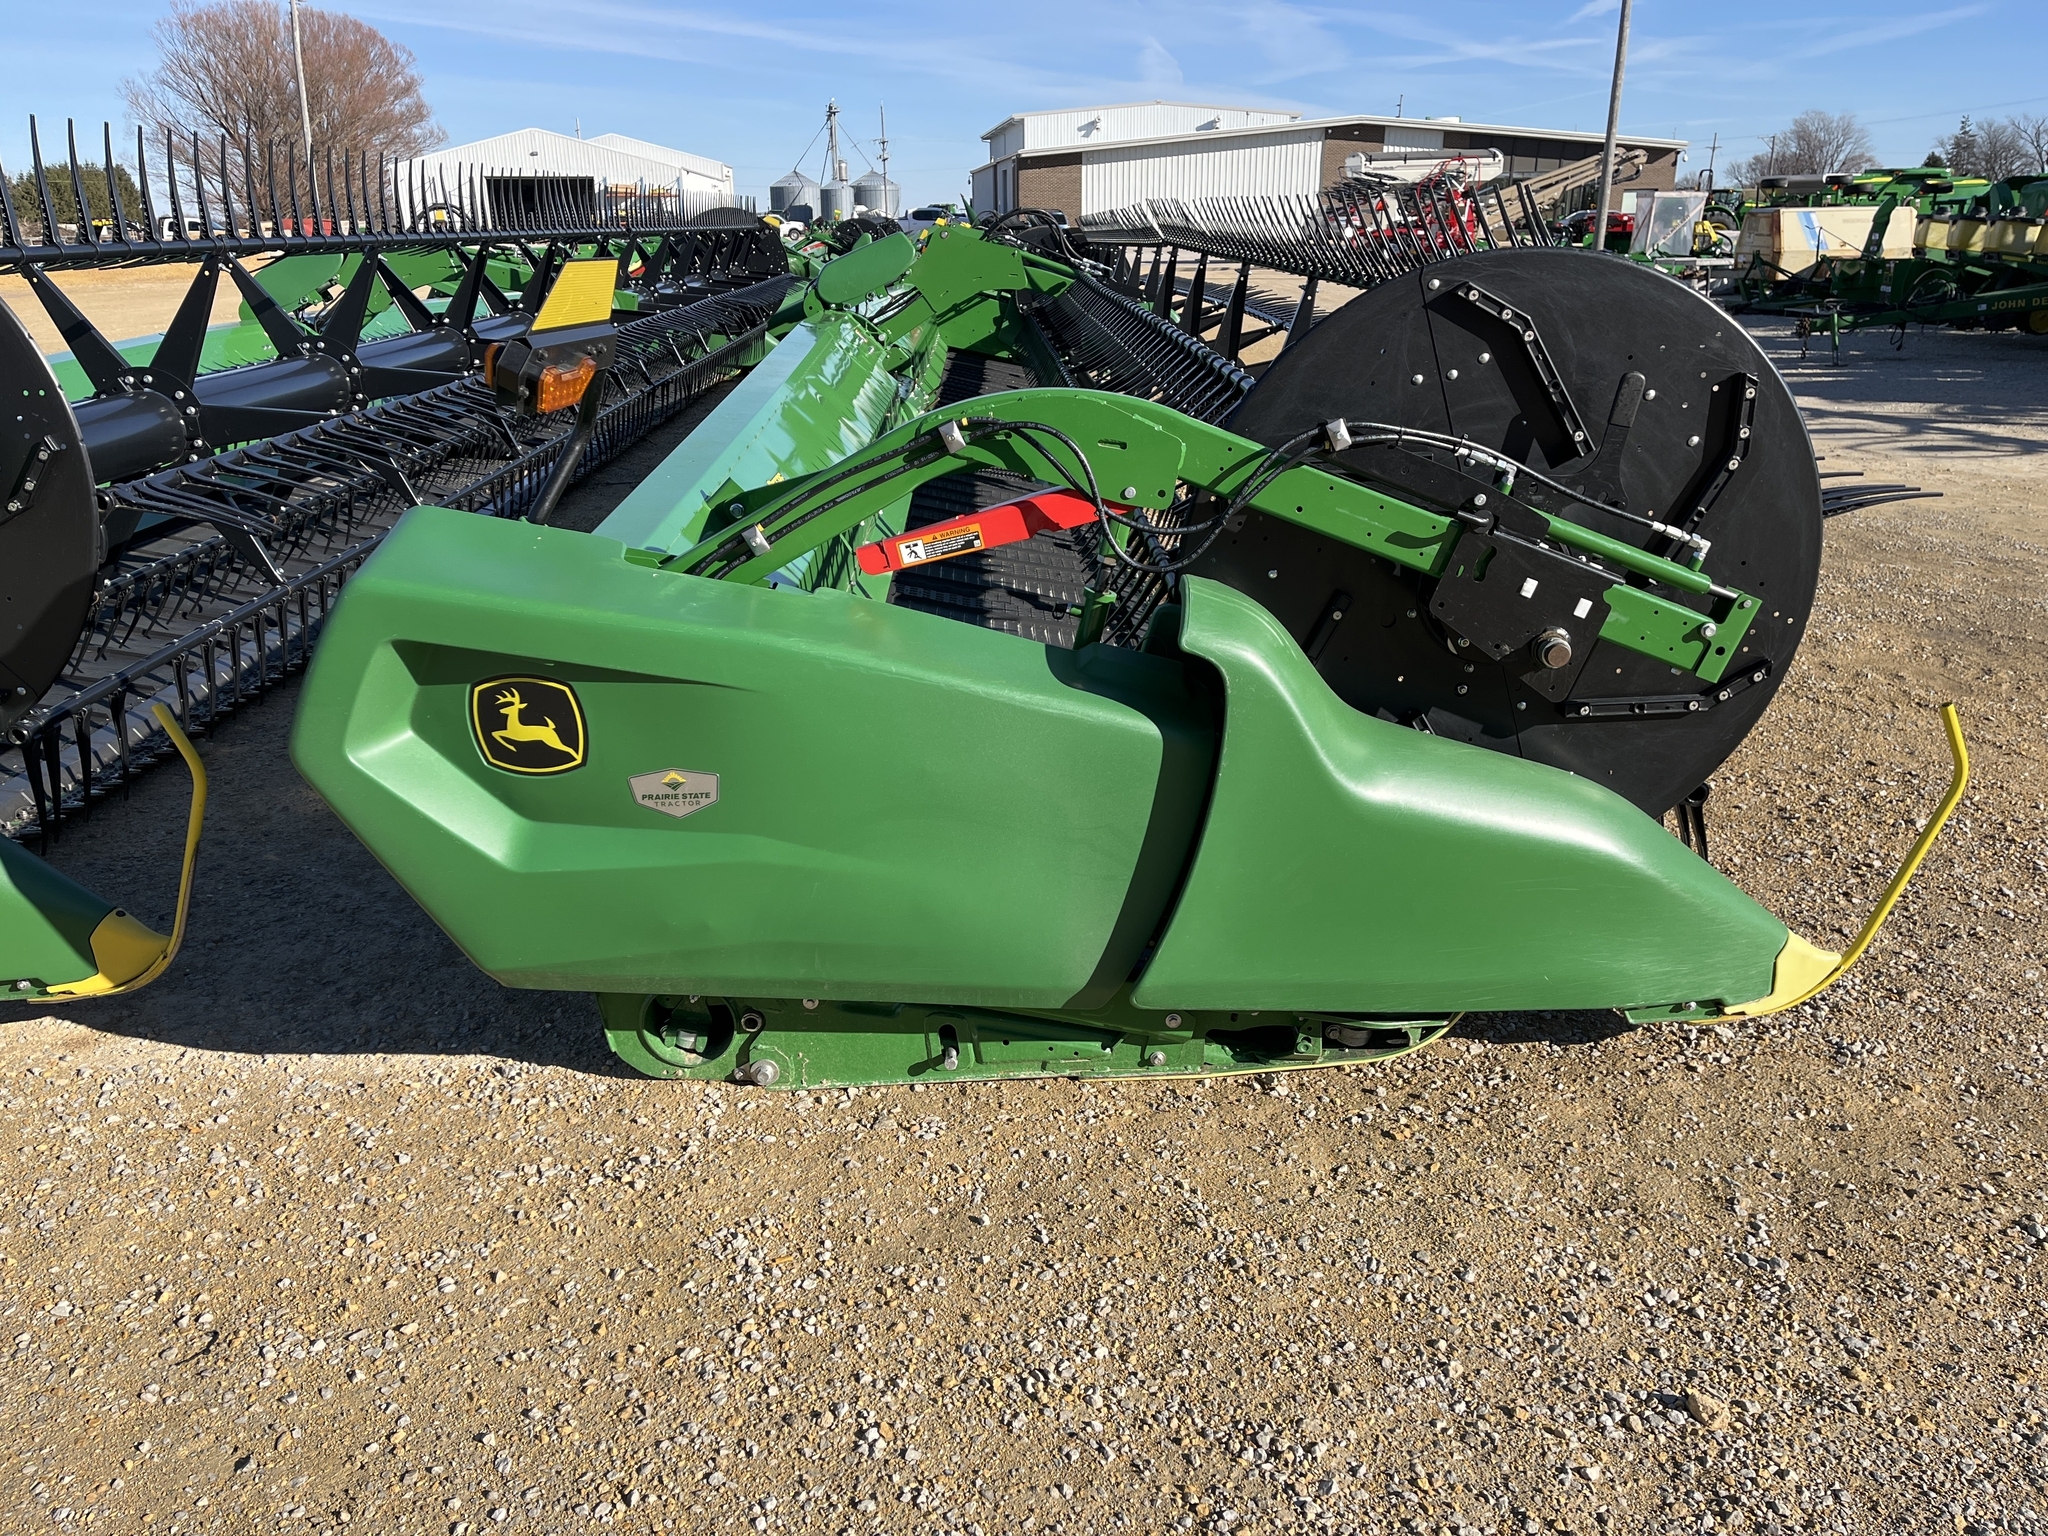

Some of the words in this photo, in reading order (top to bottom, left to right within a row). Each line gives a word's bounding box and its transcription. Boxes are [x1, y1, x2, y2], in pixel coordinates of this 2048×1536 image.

[1991, 298, 2026, 310] JOHN
[940, 526, 971, 538] WARNING
[641, 793, 680, 801] PRAIRIE
